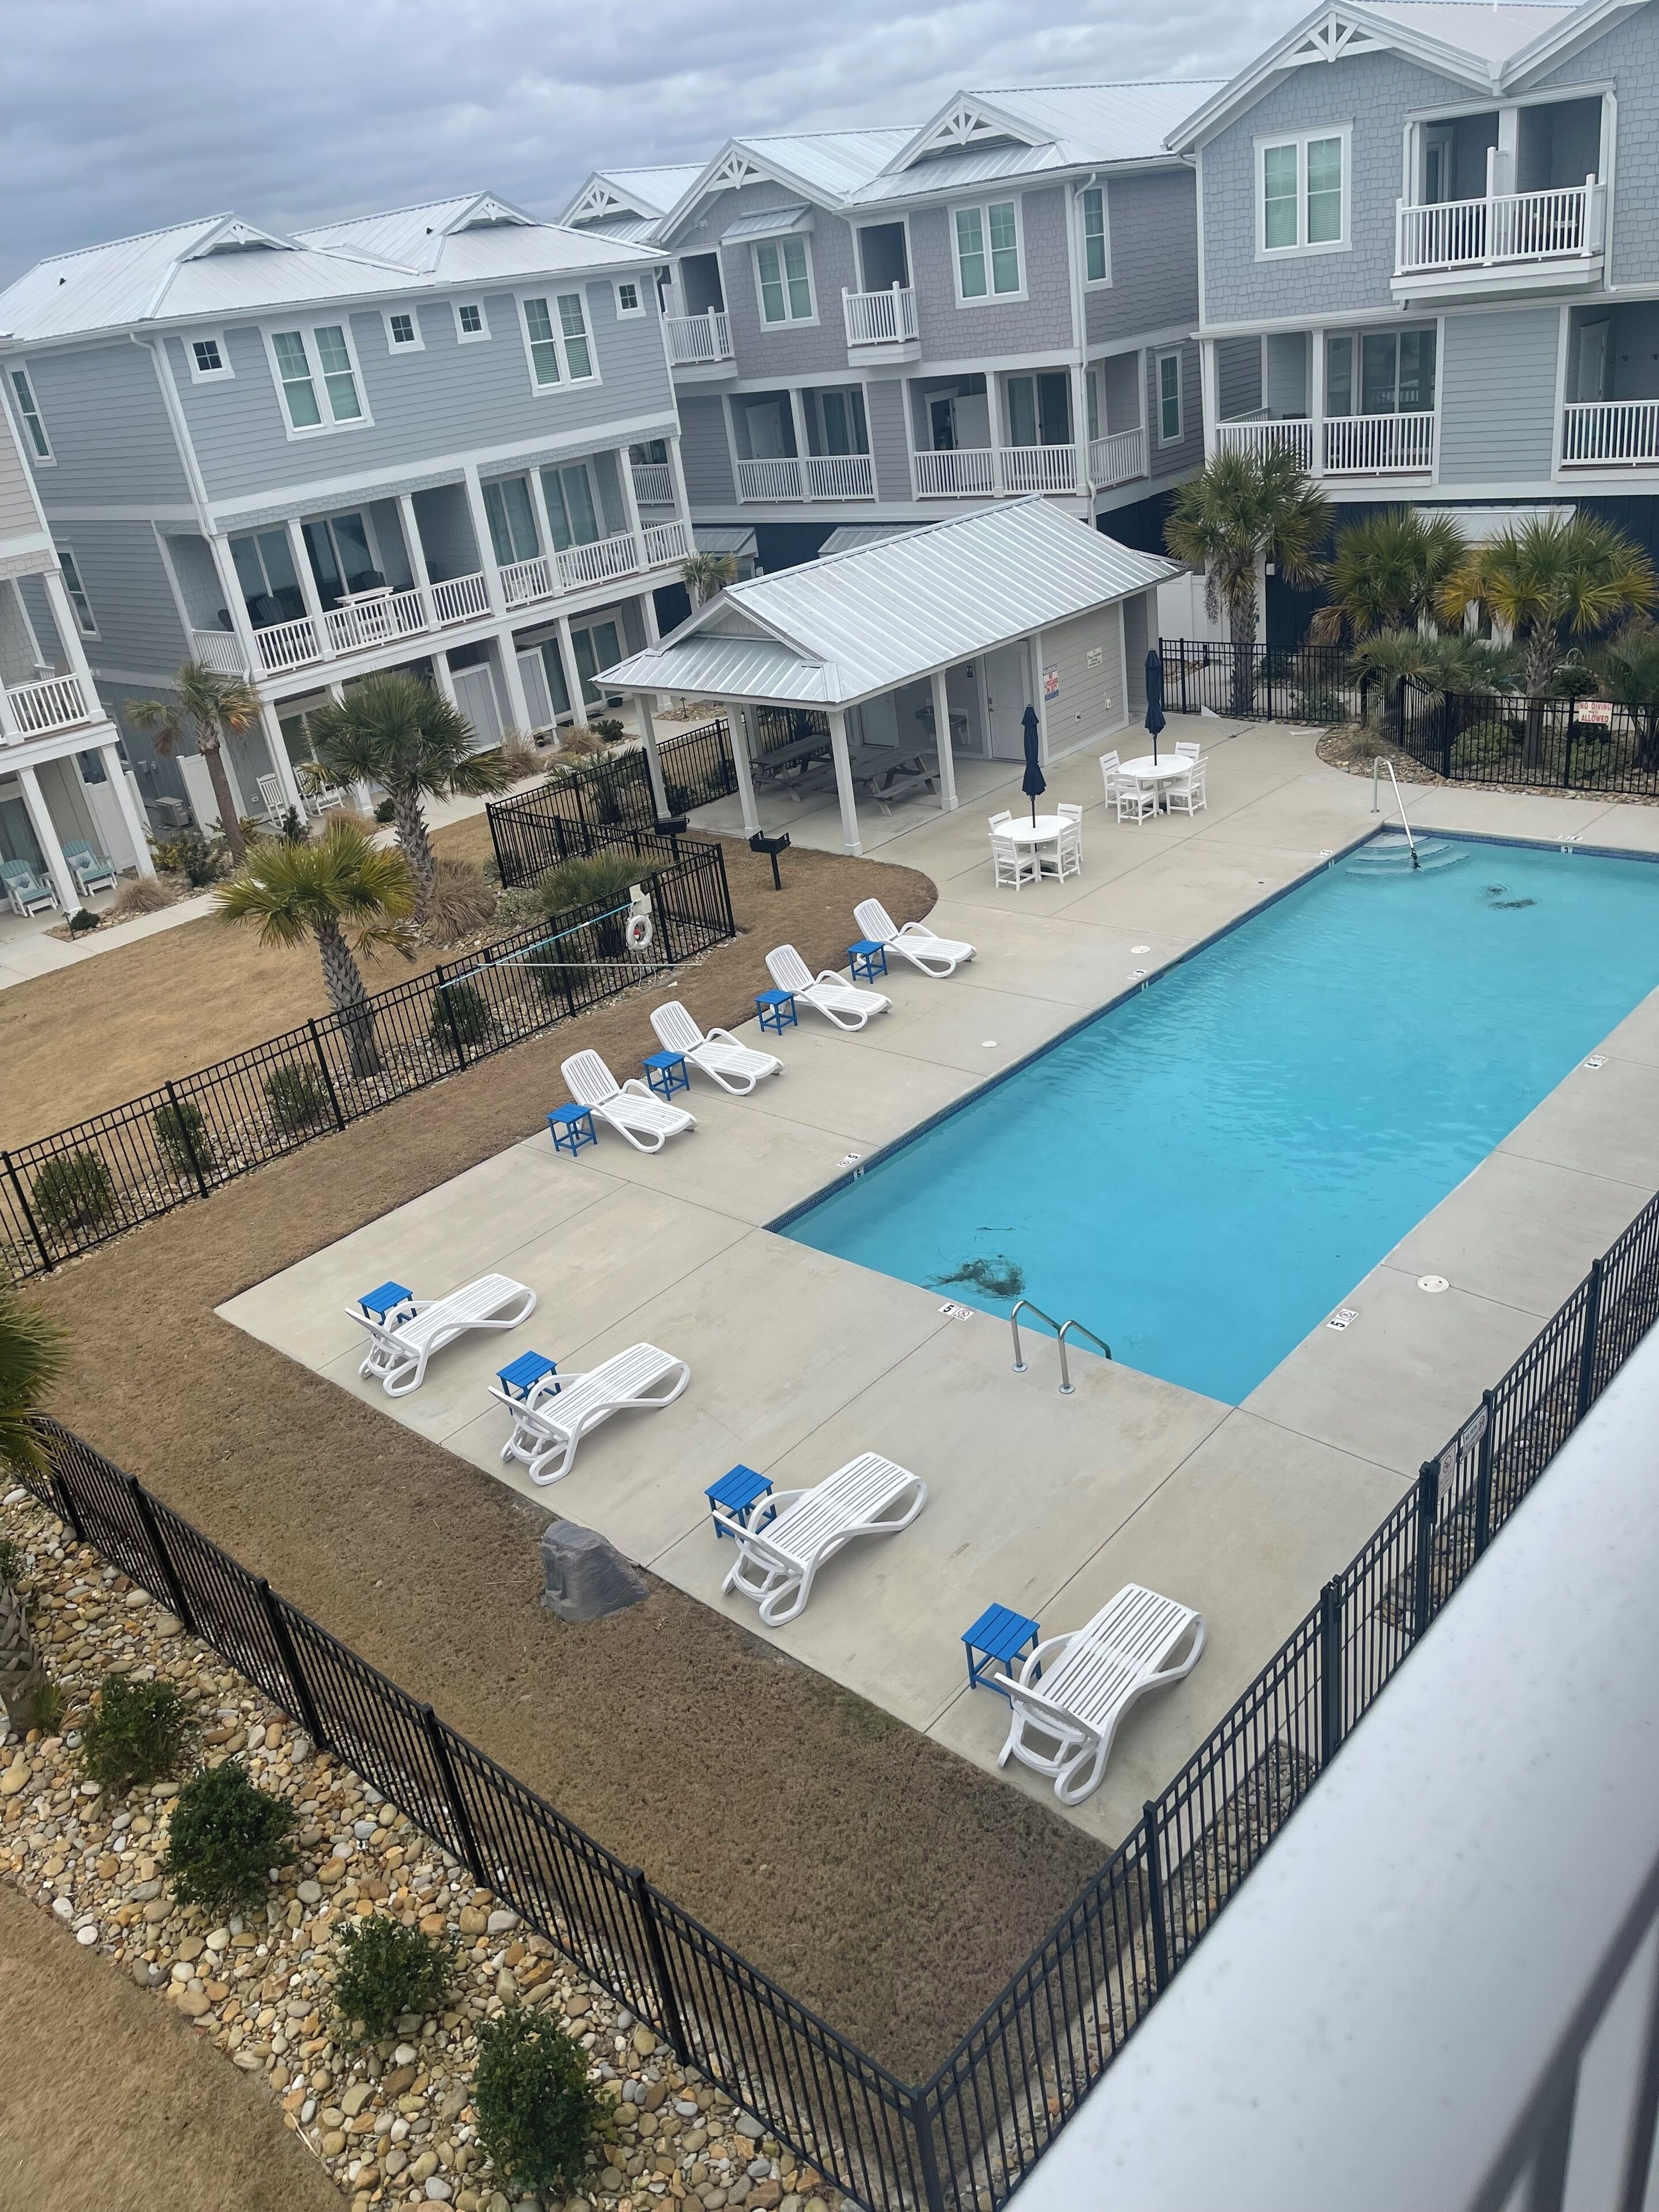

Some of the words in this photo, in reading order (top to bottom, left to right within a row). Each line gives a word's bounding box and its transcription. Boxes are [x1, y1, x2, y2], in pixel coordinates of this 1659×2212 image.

[1581, 714, 1609, 722] ALLOWED
[857, 1169, 861, 1178] 5
[943, 1304, 955, 1313] 5
